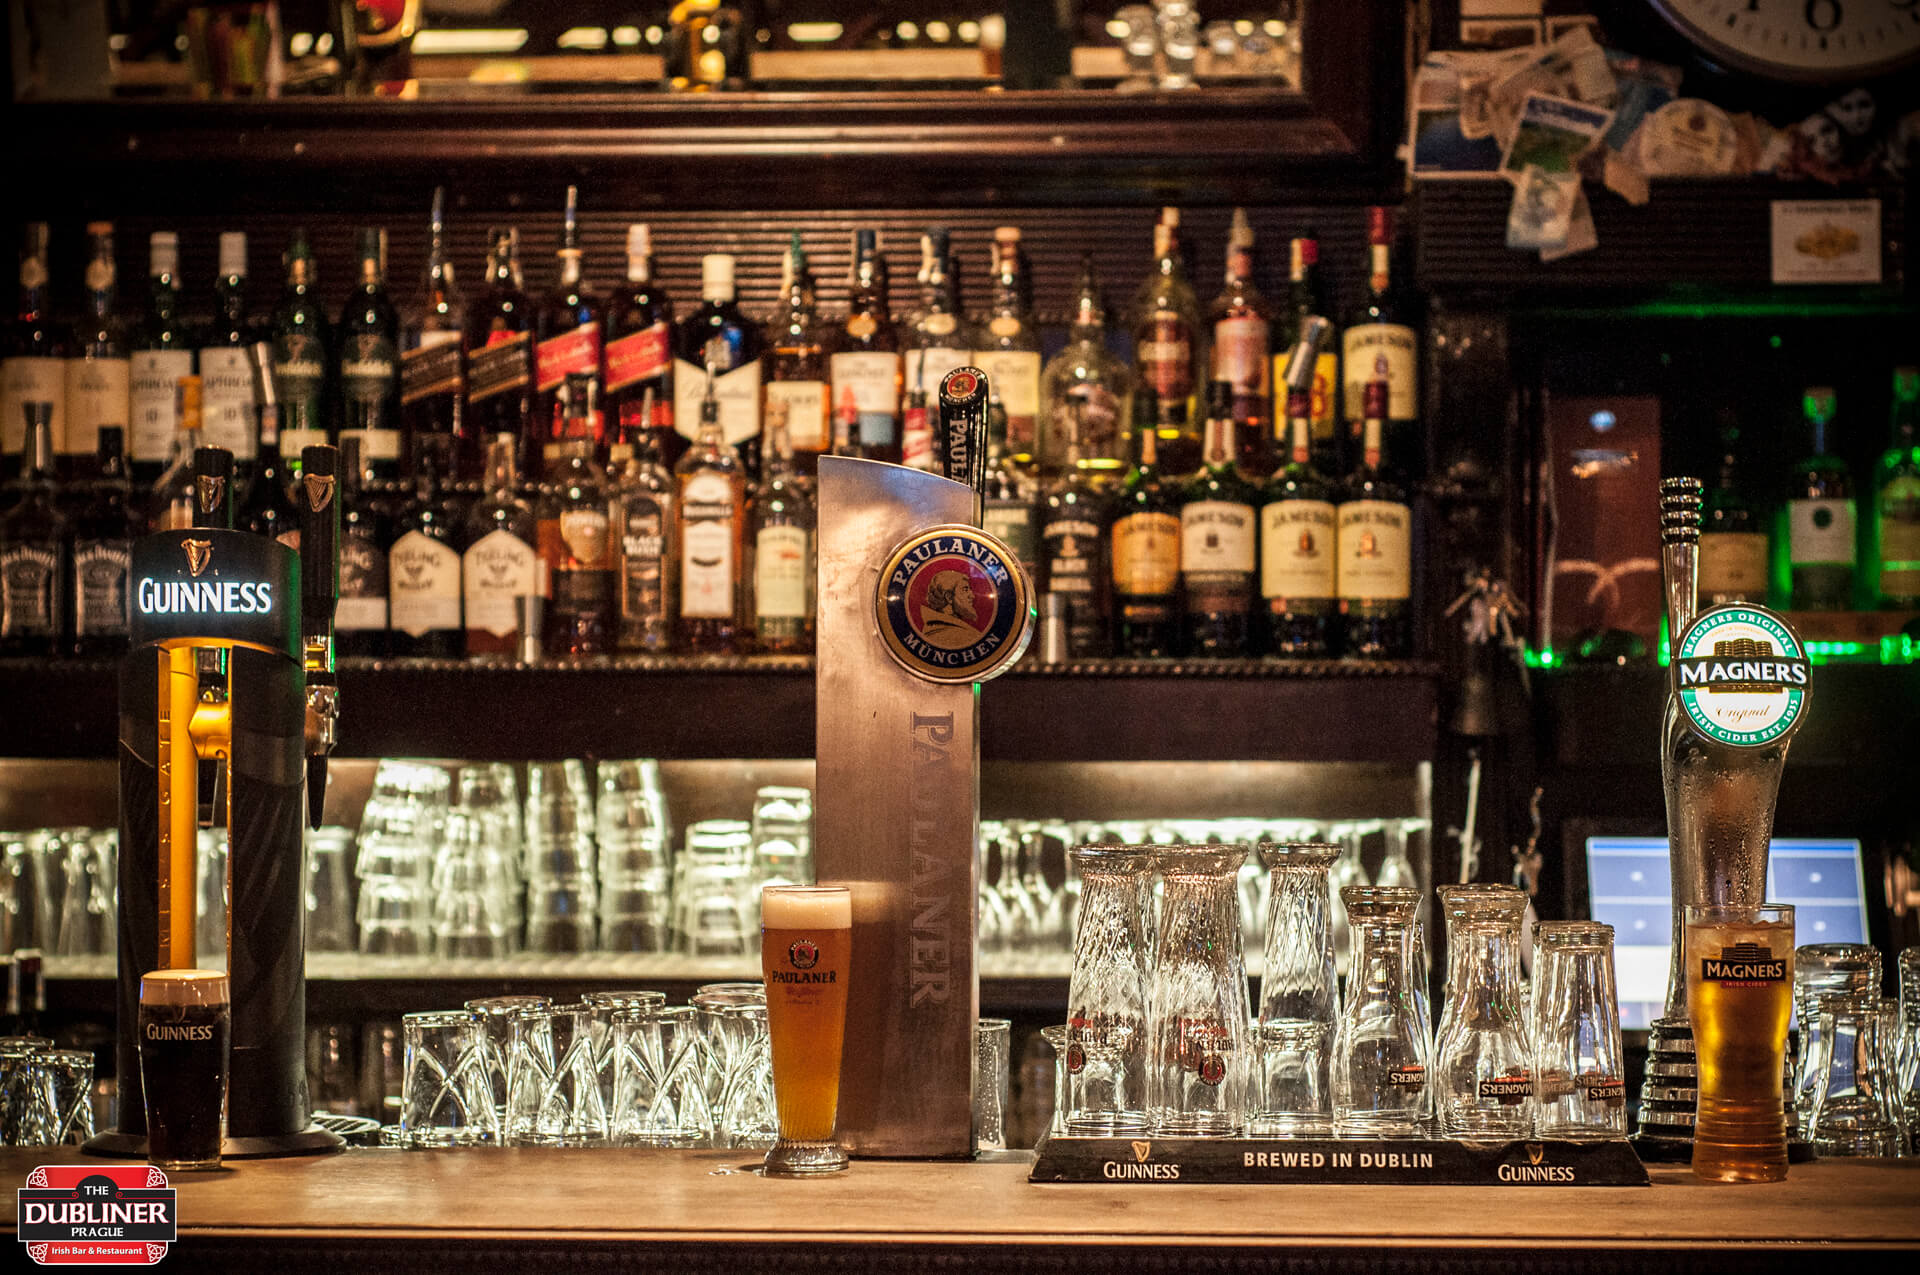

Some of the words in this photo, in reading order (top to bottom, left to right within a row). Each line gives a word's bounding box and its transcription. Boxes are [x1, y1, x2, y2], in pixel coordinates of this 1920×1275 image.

[892, 538, 1009, 586] PAULANER
[138, 577, 272, 614] GUINNESS
[1684, 612, 1734, 655] MAGNERS
[1737, 613, 1795, 653] ORIGINAL
[903, 632, 1000, 666] MÜNCHEN
[1680, 661, 1808, 686] MAGNERS
[1688, 701, 1716, 733] IRISH
[1718, 729, 1758, 743] CIDER
[1762, 724, 1786, 740] EST.
[1783, 698, 1800, 724] 1935
[910, 710, 955, 1009] PAULANER
[772, 970, 837, 984] PAULANER
[1707, 961, 1783, 979] MAGNERS
[146, 1023, 214, 1041] GUINNESS
[1481, 1084, 1534, 1096] MAGNERS
[1103, 1161, 1180, 1179] GUINNESS
[1243, 1152, 1325, 1168] BREWED
[1332, 1153, 1353, 1168] IN
[1360, 1153, 1433, 1168] DUBLIN
[1498, 1164, 1575, 1182] GUINNESS
